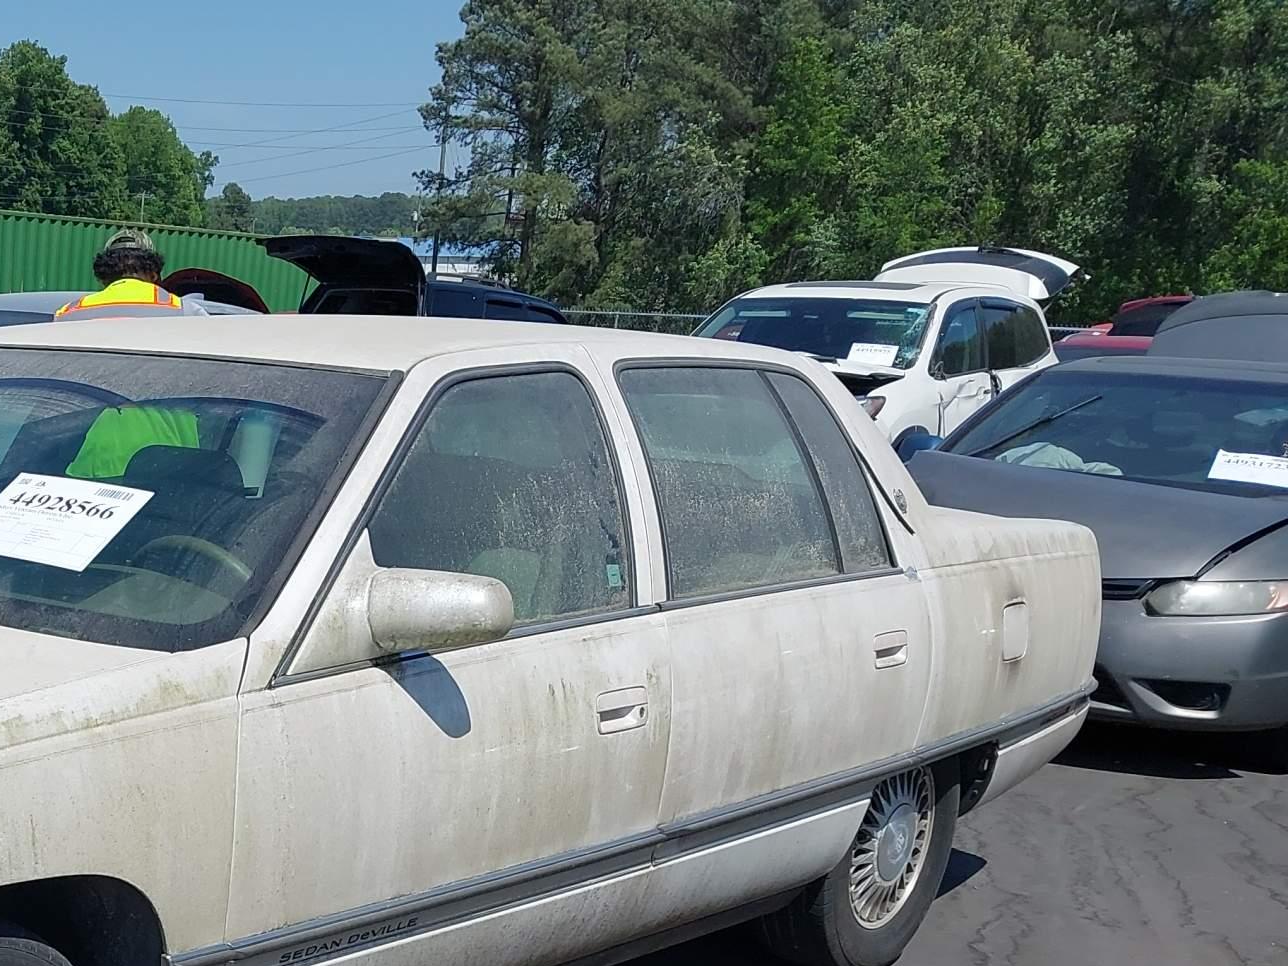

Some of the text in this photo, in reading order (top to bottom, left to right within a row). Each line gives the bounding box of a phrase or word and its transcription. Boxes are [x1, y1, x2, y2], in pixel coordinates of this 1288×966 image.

[10, 491, 120, 520] 44928566
[279, 917, 418, 964] SEDAN DeVILLE
